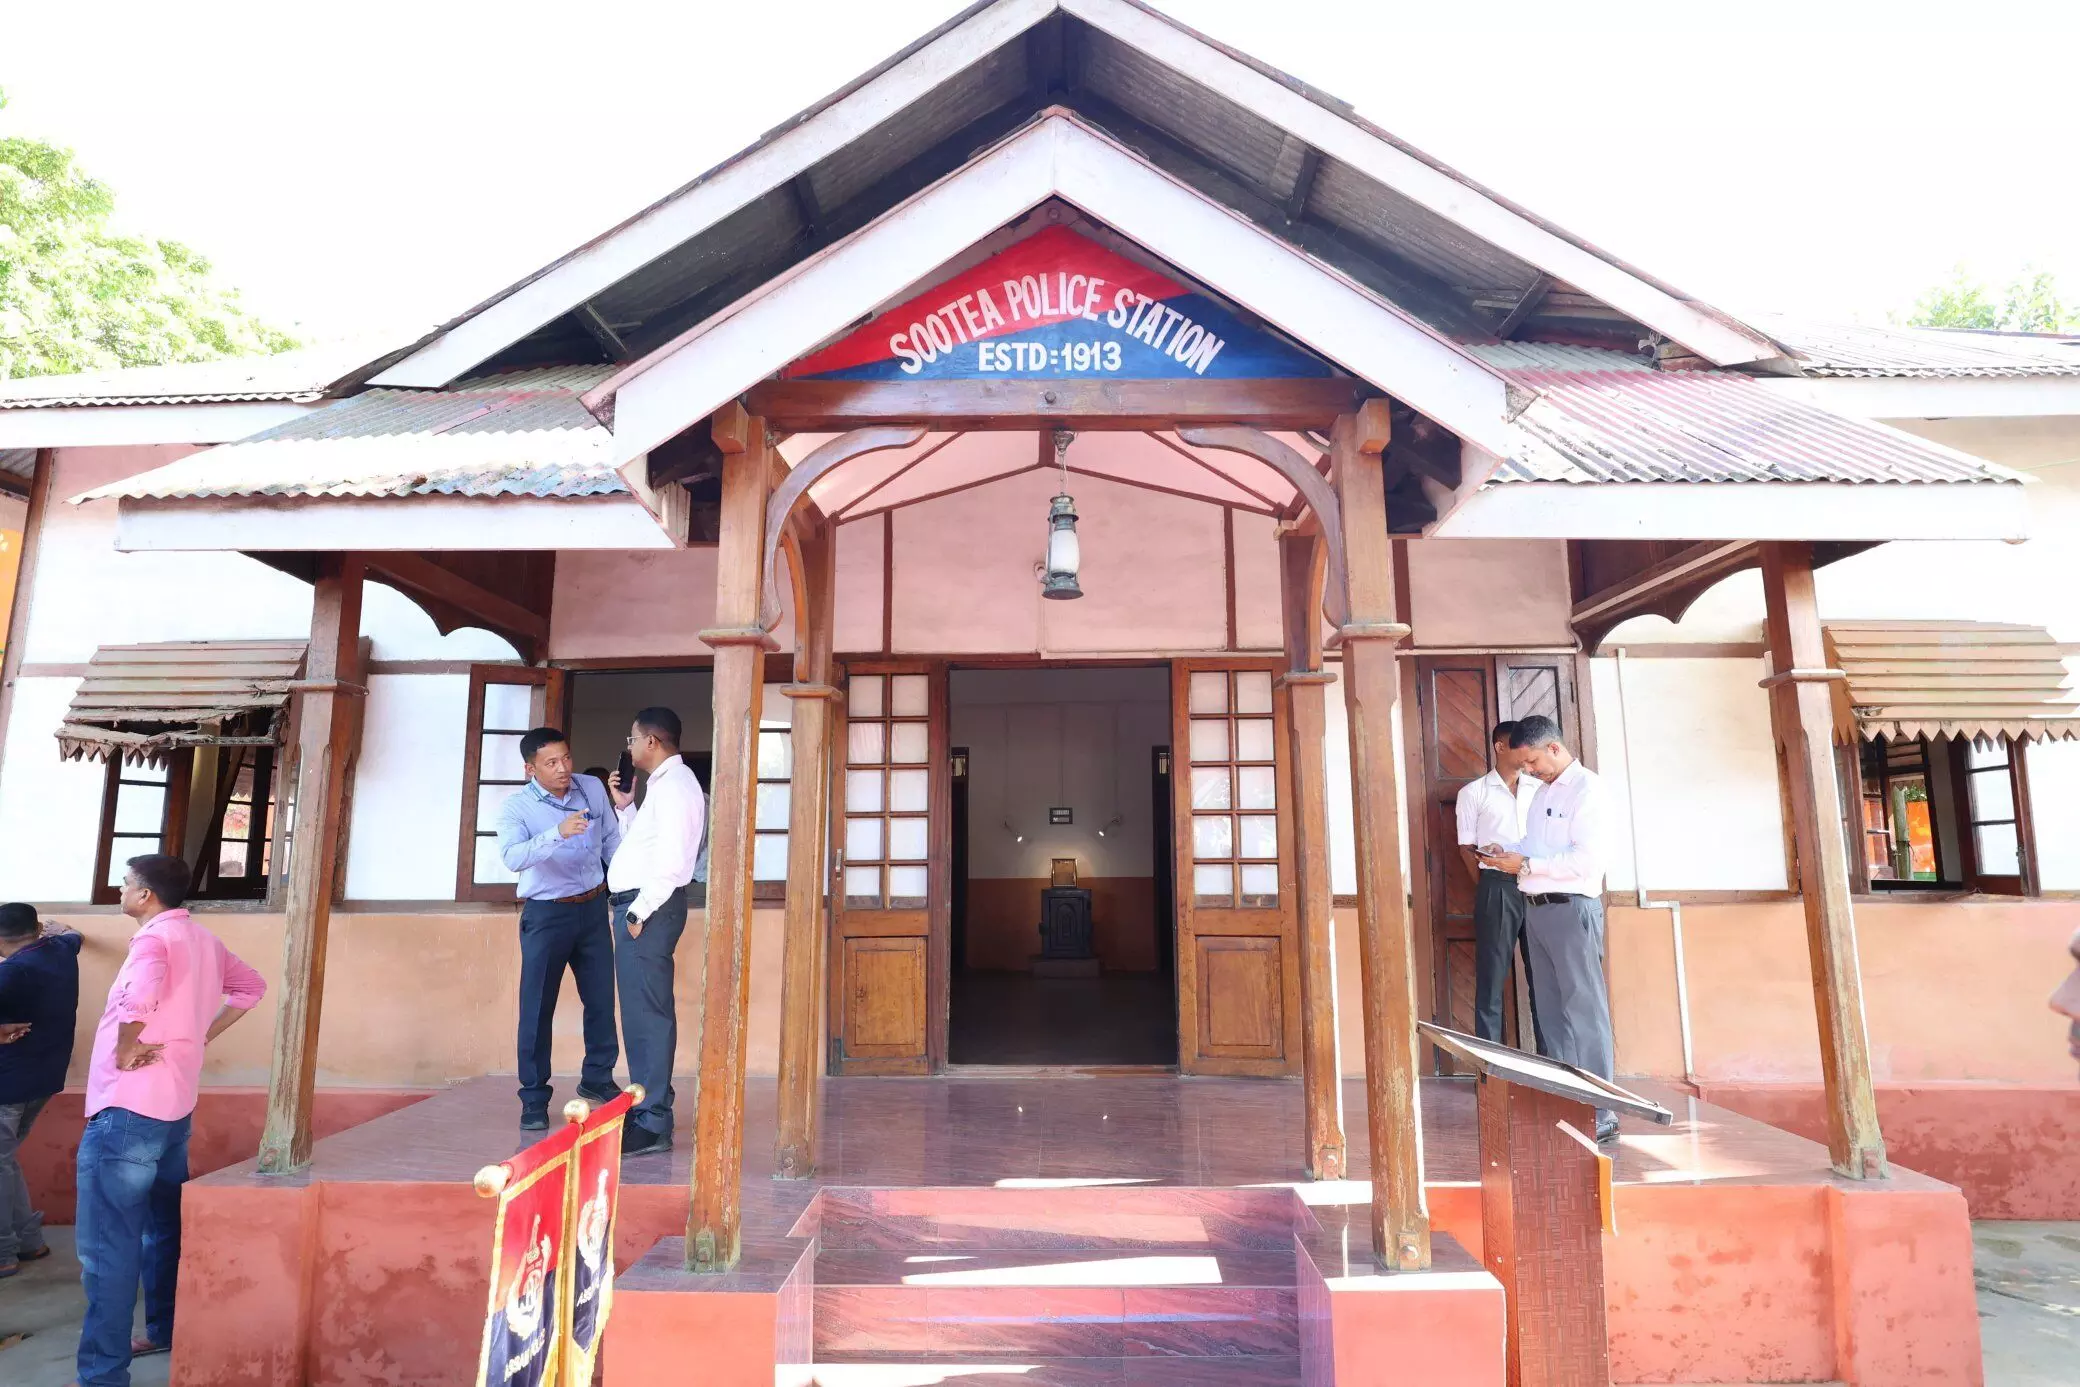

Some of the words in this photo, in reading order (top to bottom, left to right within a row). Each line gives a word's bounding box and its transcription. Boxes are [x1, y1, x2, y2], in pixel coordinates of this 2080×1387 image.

[890, 288, 1005, 374] SOOTEA
[1003, 272, 1105, 321] POLICE
[1108, 288, 1225, 375] STATION
